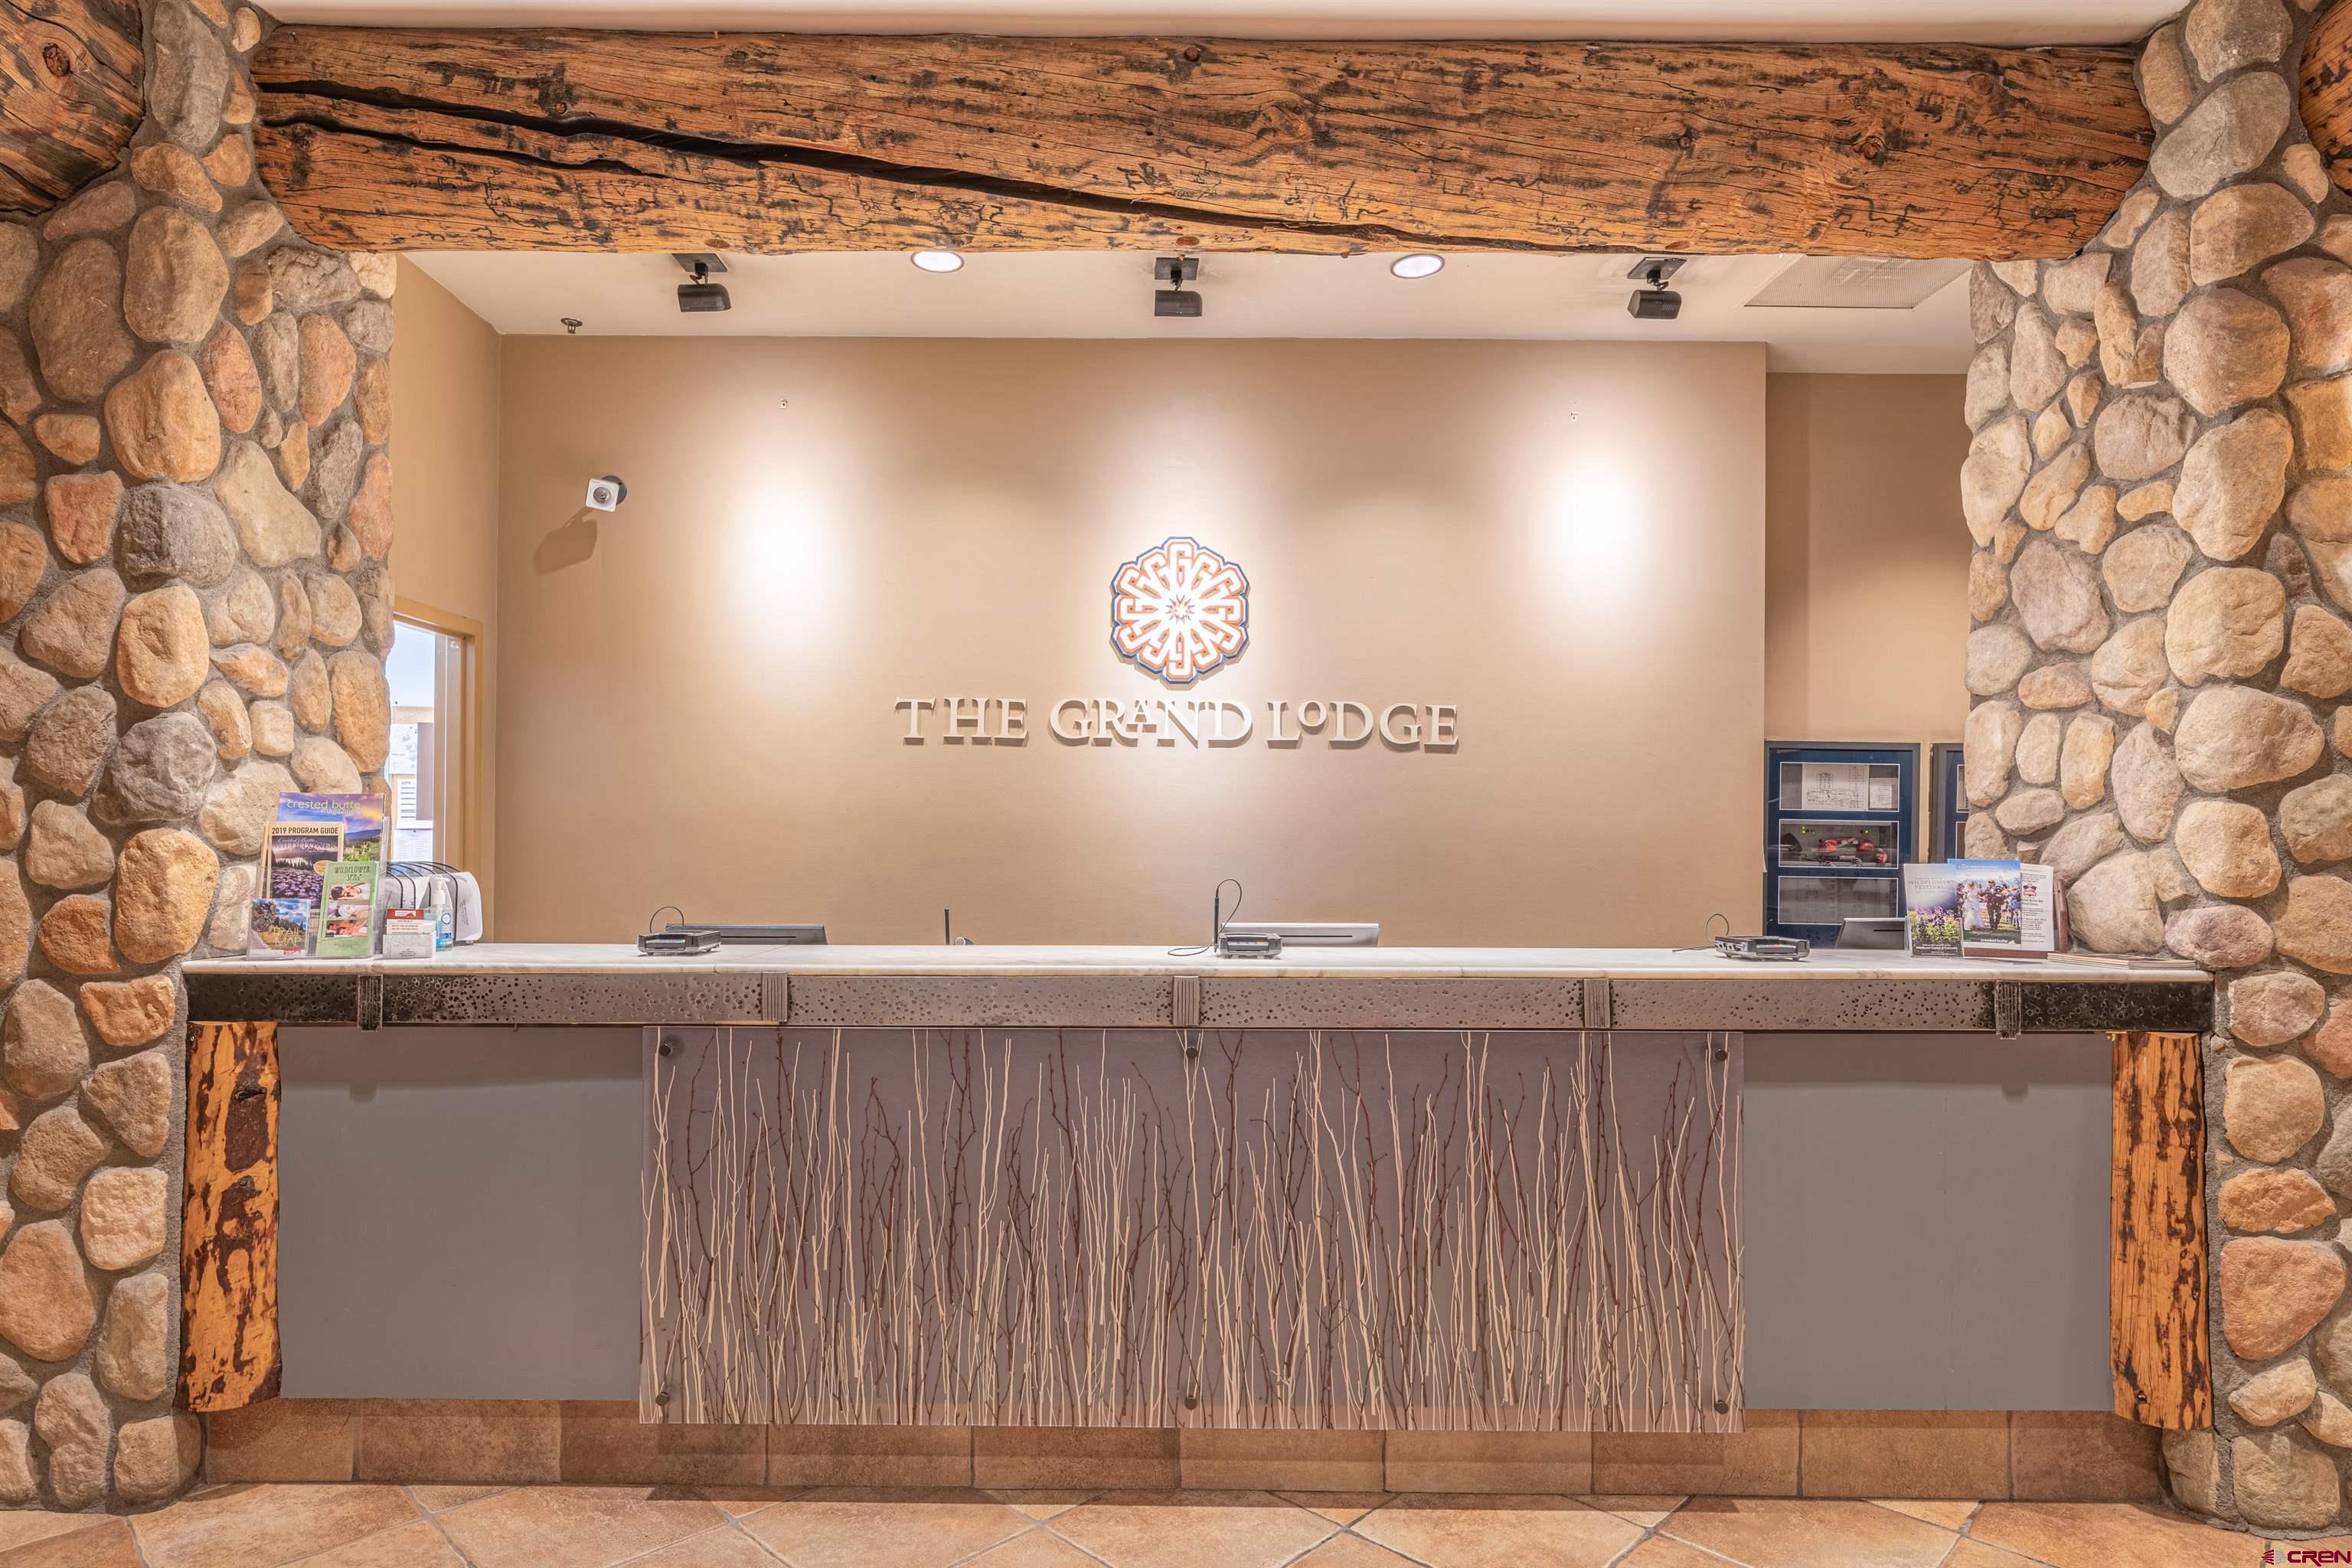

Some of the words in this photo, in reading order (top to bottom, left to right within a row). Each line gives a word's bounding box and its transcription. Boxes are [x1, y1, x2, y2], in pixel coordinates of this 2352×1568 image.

[895, 697, 1027, 745] THE
[1050, 697, 1253, 748] GRAND
[287, 800, 328, 808] crested
[332, 800, 361, 810] butte
[272, 927, 302, 937] TRAIL
[276, 936, 302, 946] MAP
